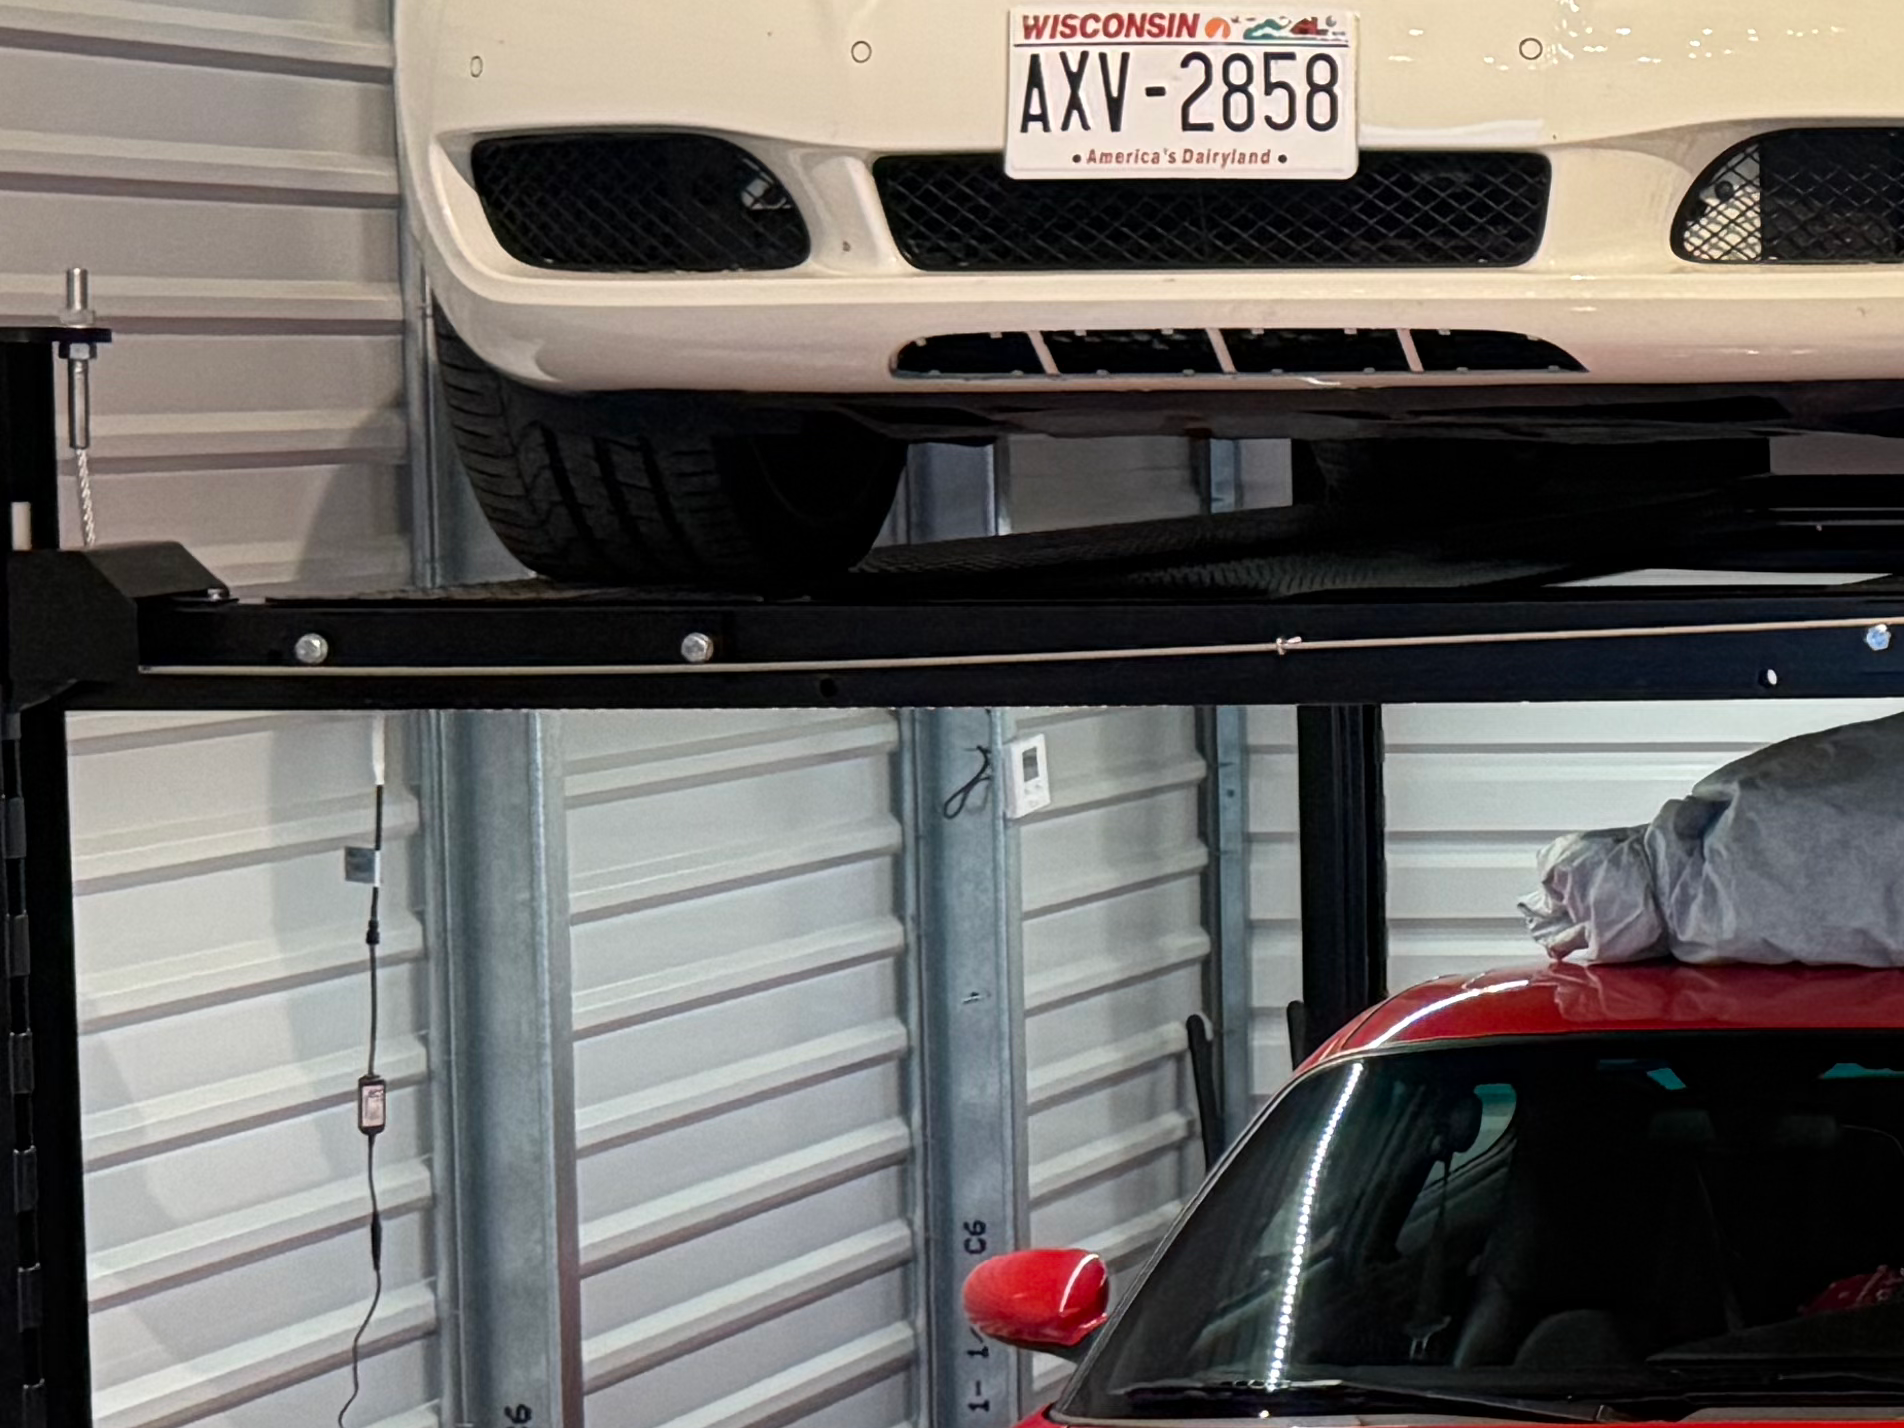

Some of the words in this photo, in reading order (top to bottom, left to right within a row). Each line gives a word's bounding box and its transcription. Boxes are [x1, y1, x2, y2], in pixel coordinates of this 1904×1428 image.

[1021, 12, 1200, 40] WISCONSIN
[1019, 50, 1339, 133] AXV-2858
[1086, 147, 1177, 165] America's
[1181, 147, 1271, 169] Dairyland
[963, 1219, 987, 1255] C6
